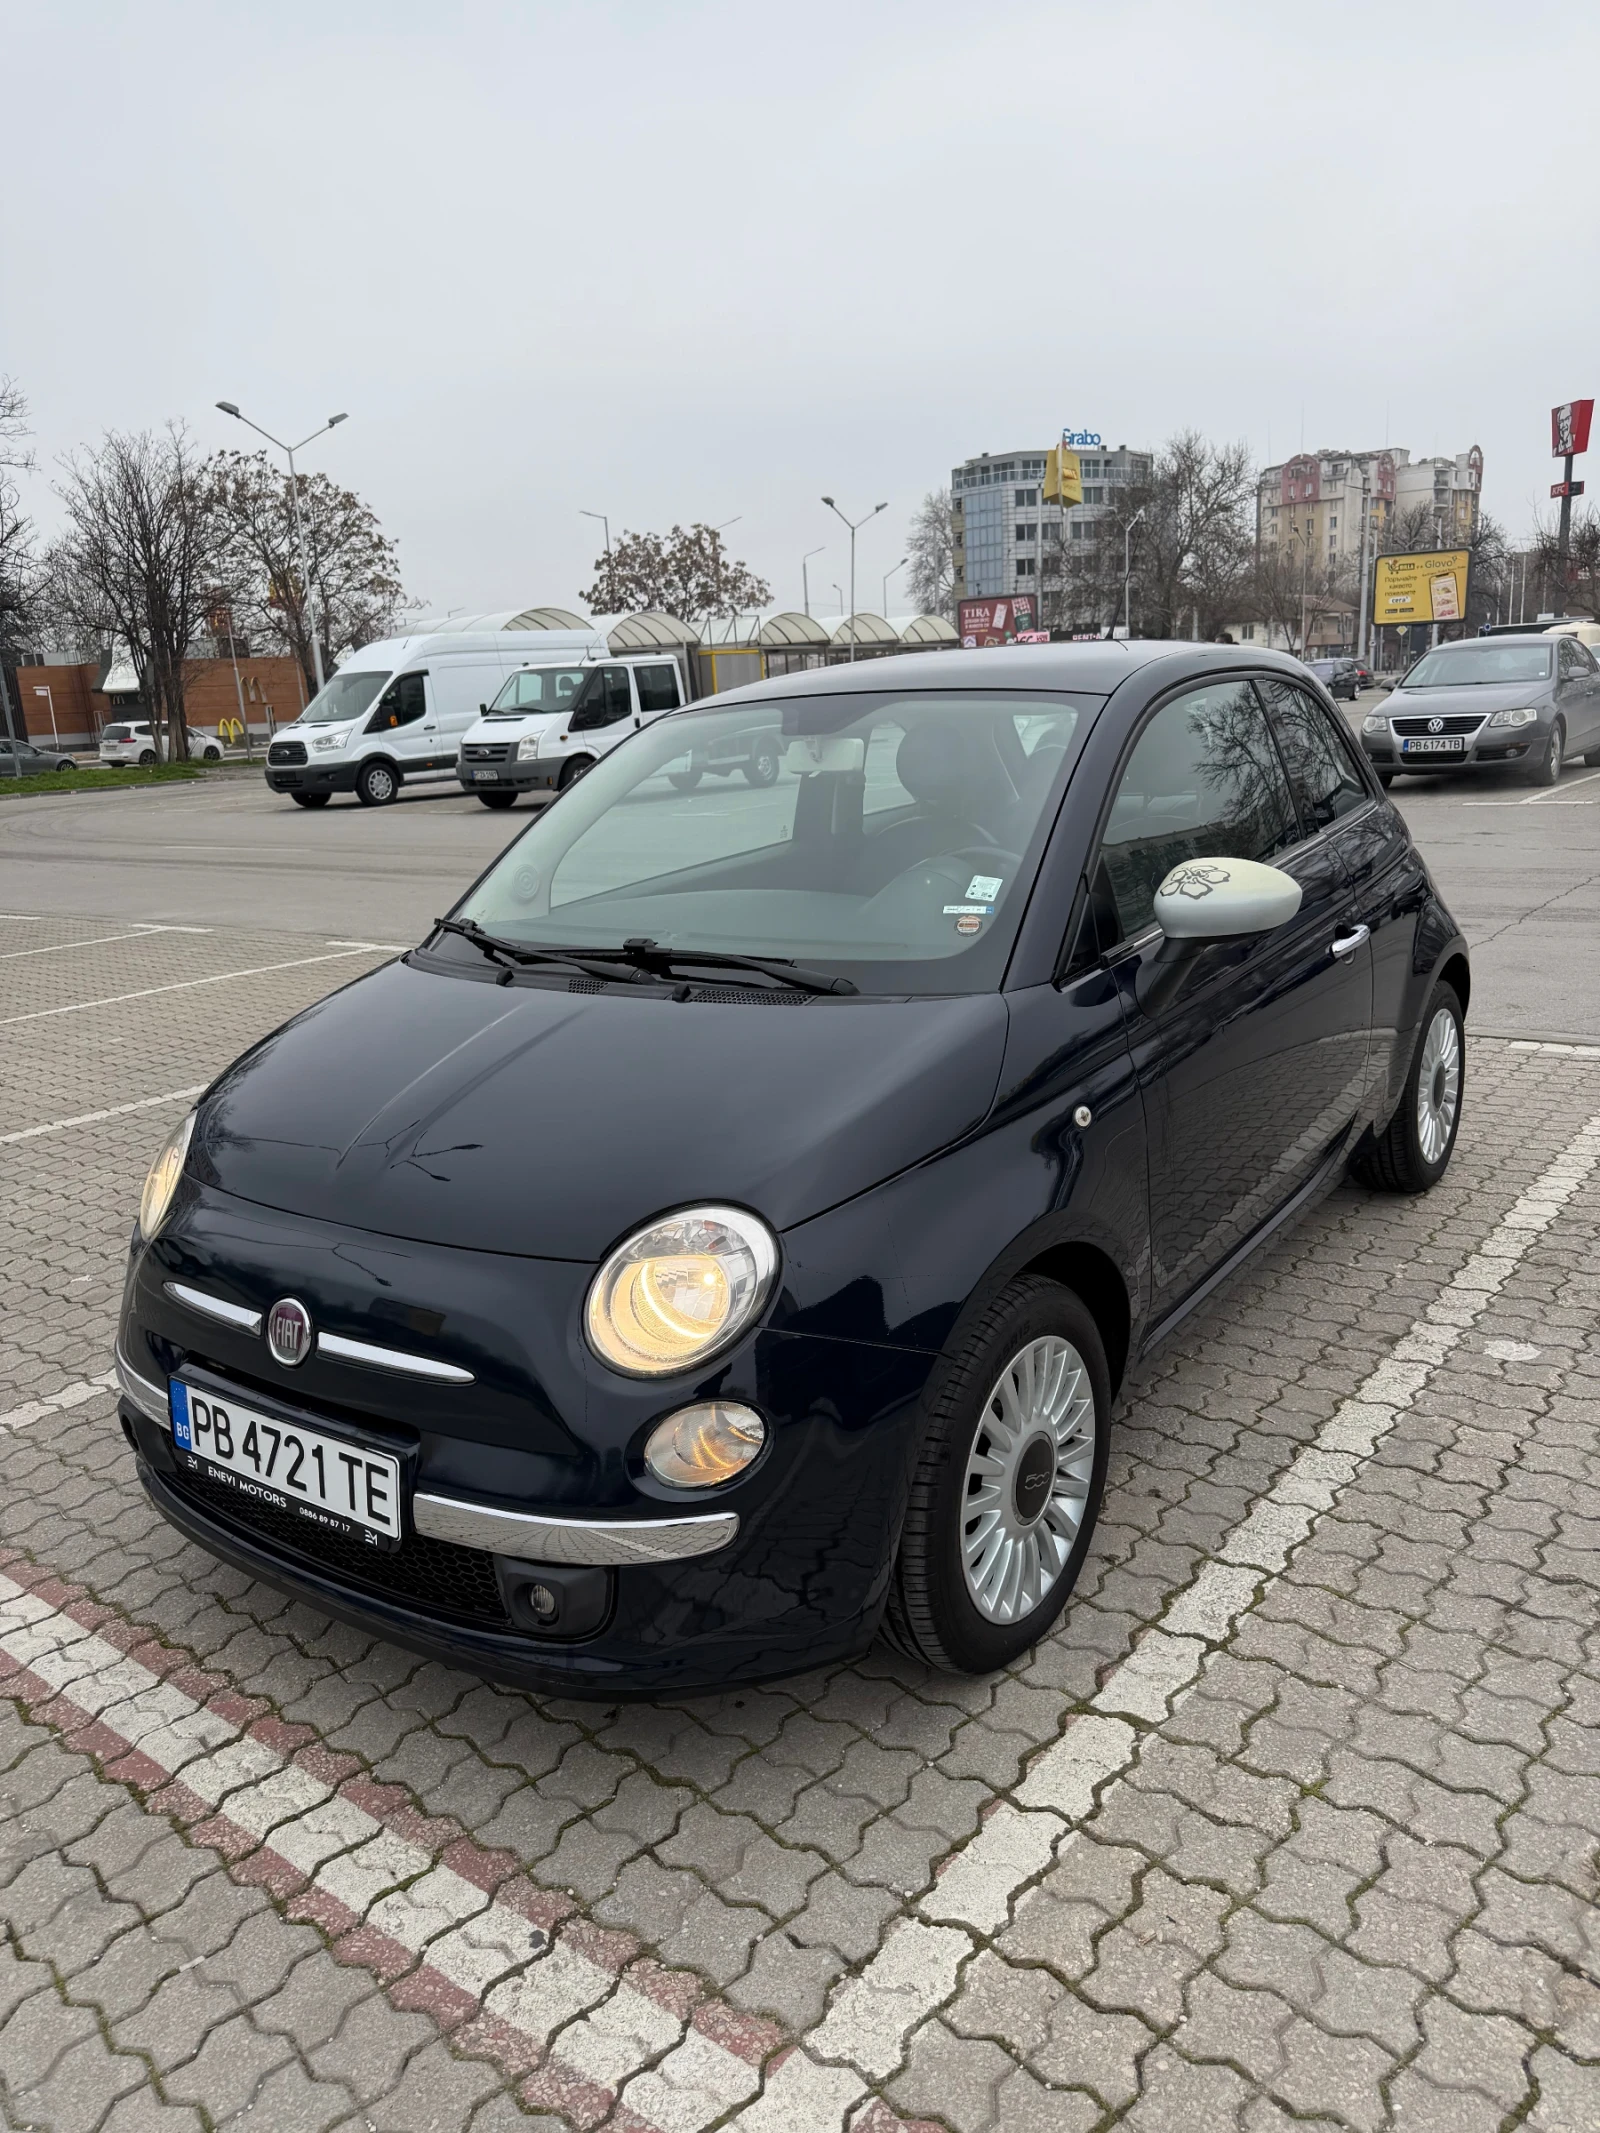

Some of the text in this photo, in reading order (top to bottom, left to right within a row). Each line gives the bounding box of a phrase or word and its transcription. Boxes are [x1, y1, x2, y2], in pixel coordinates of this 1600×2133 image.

[1552, 484, 1565, 495] KFC
[1425, 559, 1453, 569] Glovo
[963, 607, 990, 617] TIRA
[1409, 740, 1460, 751] PB 6174 TB
[276, 1317, 301, 1349] FIAT
[176, 1421, 190, 1441] BG
[191, 1396, 391, 1526] PB 4721 TE
[208, 1465, 287, 1508] ENEVI MOTORS
[1024, 1472, 1050, 1490] 500
[299, 1506, 351, 1533] 0886 89 87 17
